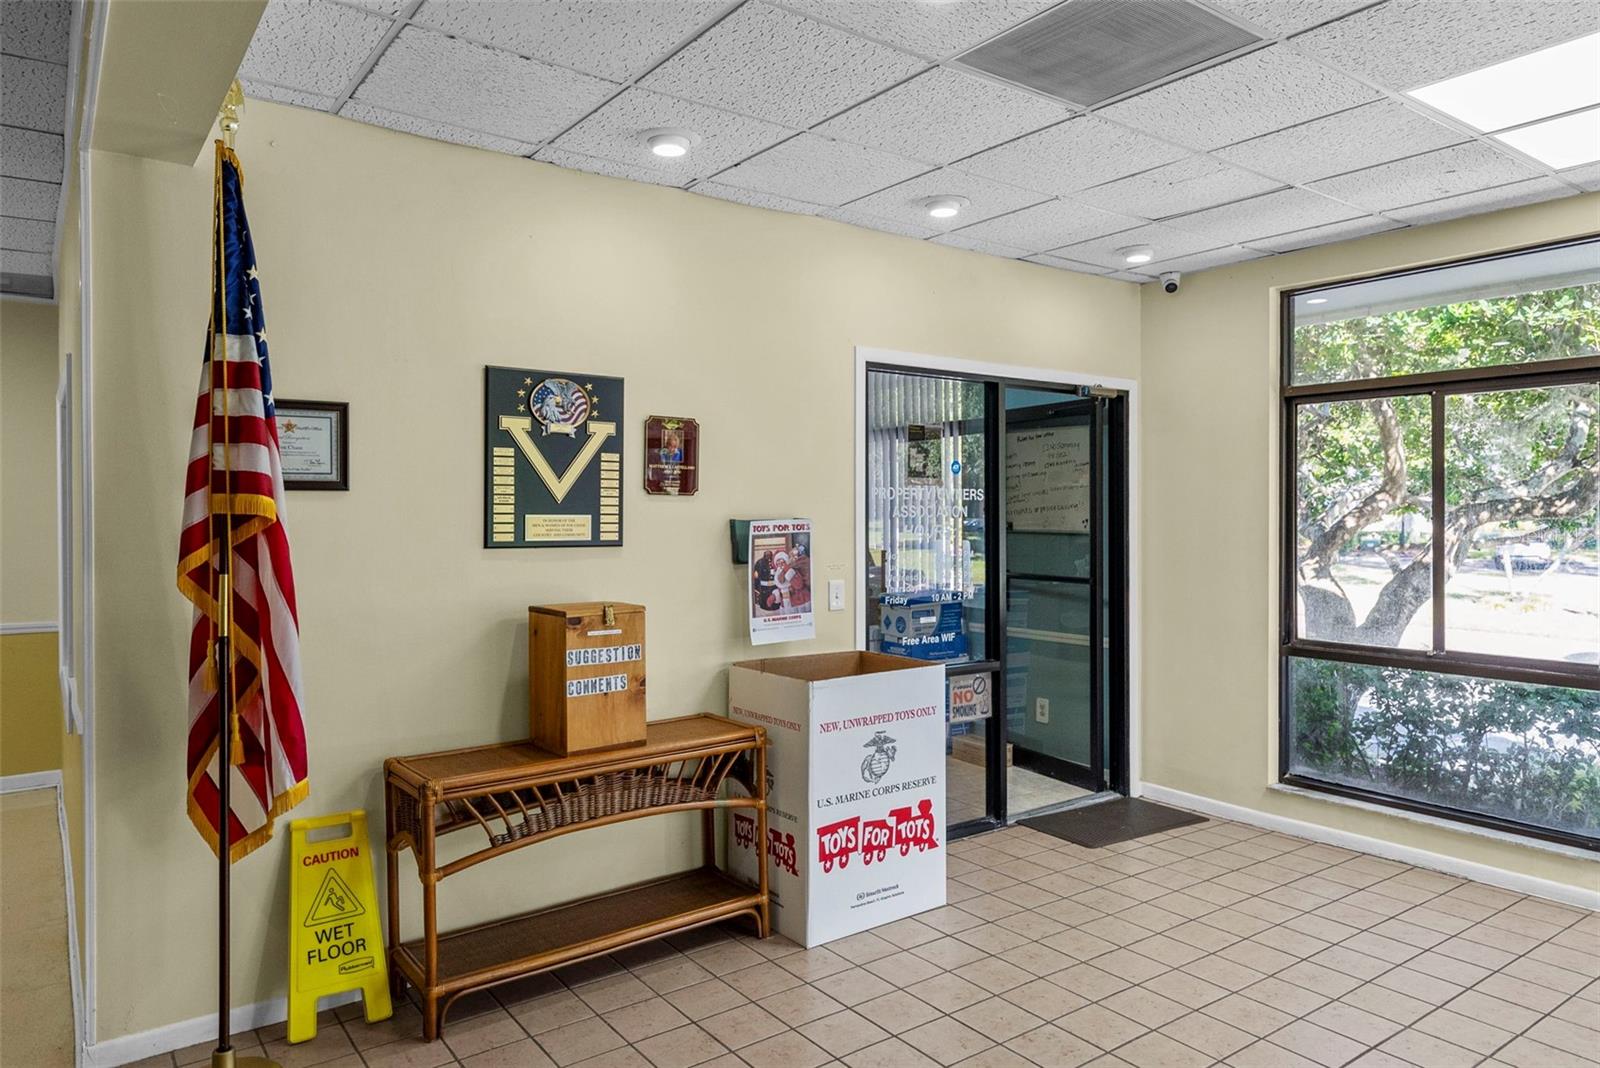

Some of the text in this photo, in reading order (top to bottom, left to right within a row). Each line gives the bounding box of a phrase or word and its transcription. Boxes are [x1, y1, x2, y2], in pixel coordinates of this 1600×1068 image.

[872, 487, 934, 500] PROPERTY
[885, 596, 908, 606] Friday
[932, 594, 940, 602] 10
[941, 592, 952, 600] AM
[958, 592, 962, 600] 2
[963, 590, 974, 600] PM
[902, 636, 920, 646] Free
[921, 634, 940, 644] Area
[567, 645, 641, 665] SUGGESTION
[953, 690, 974, 704] NO
[820, 706, 938, 734] NEW, UNWRAPPED TOYS ONLY
[817, 776, 938, 809] U.S. MARINE CORPS RESERVE
[736, 820, 752, 839] TOYS
[821, 818, 930, 856] TOYS FOR TOTS
[302, 847, 360, 866] CAUTION
[774, 842, 794, 864] TOTS
[314, 922, 355, 944] WET
[307, 938, 367, 965] FLOOR
